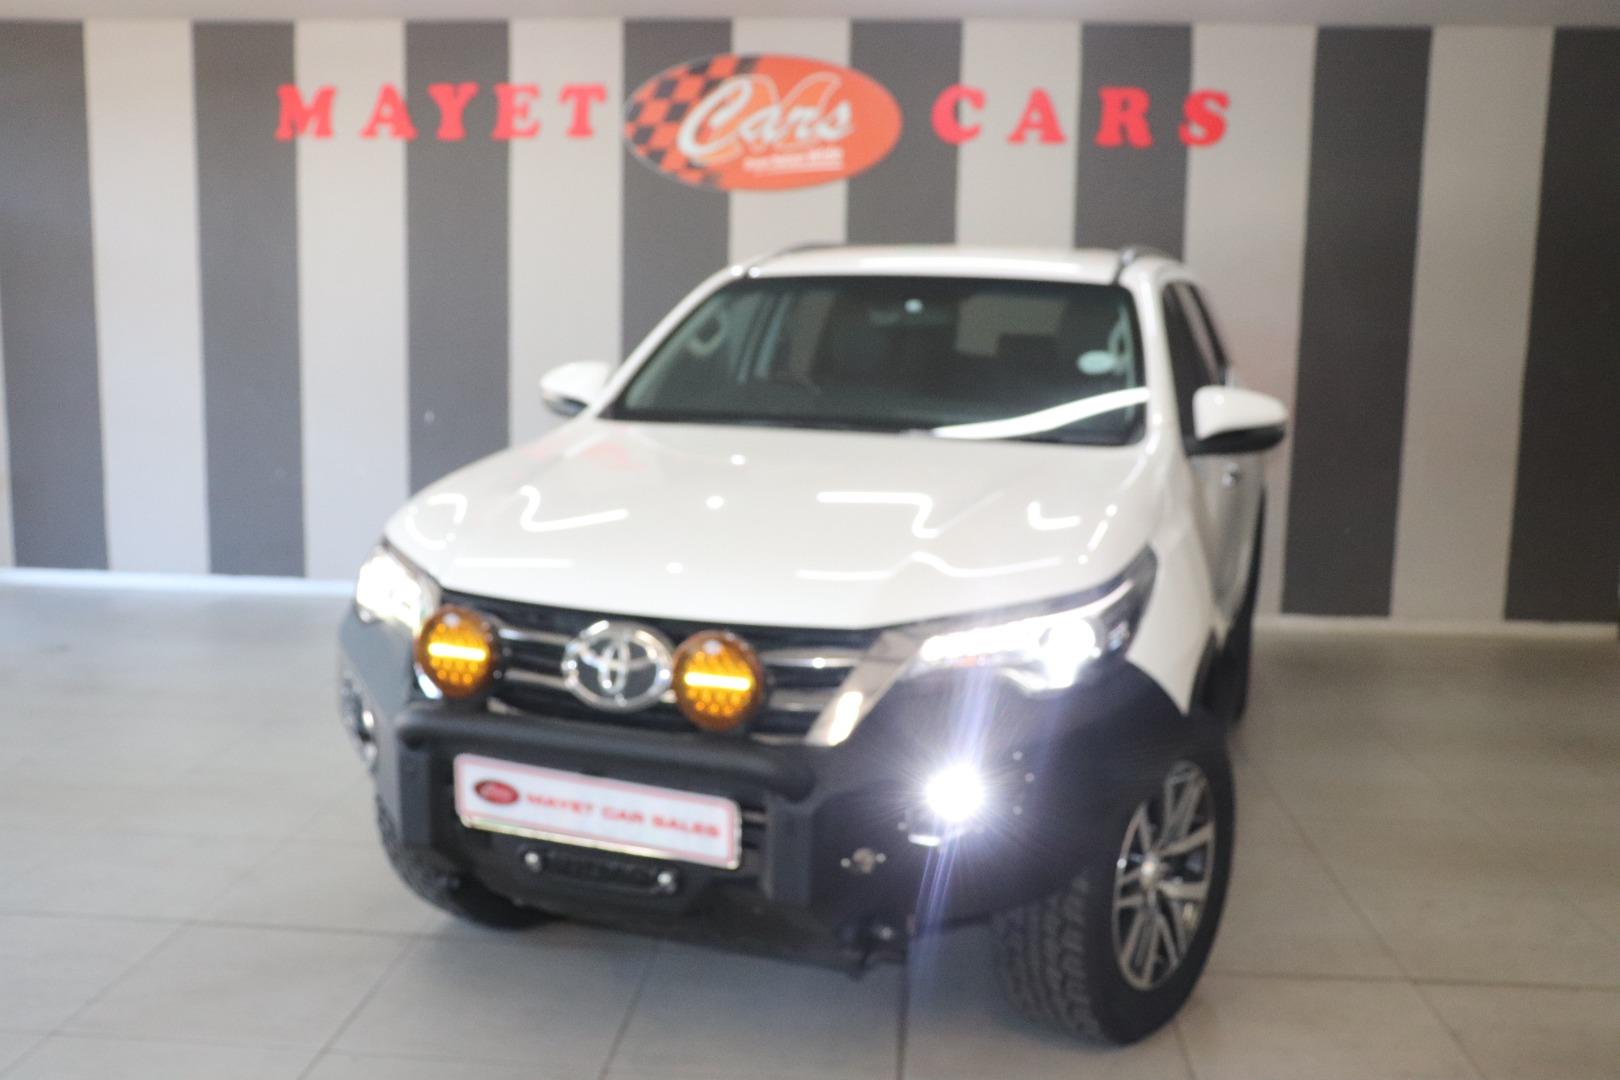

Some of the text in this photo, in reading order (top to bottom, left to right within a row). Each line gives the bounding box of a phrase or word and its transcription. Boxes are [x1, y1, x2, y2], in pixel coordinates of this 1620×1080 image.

[275, 81, 1230, 148] MAYET CARS
[677, 76, 855, 155] Cars
[602, 806, 645, 824] CAR
[651, 814, 721, 837] SALES
